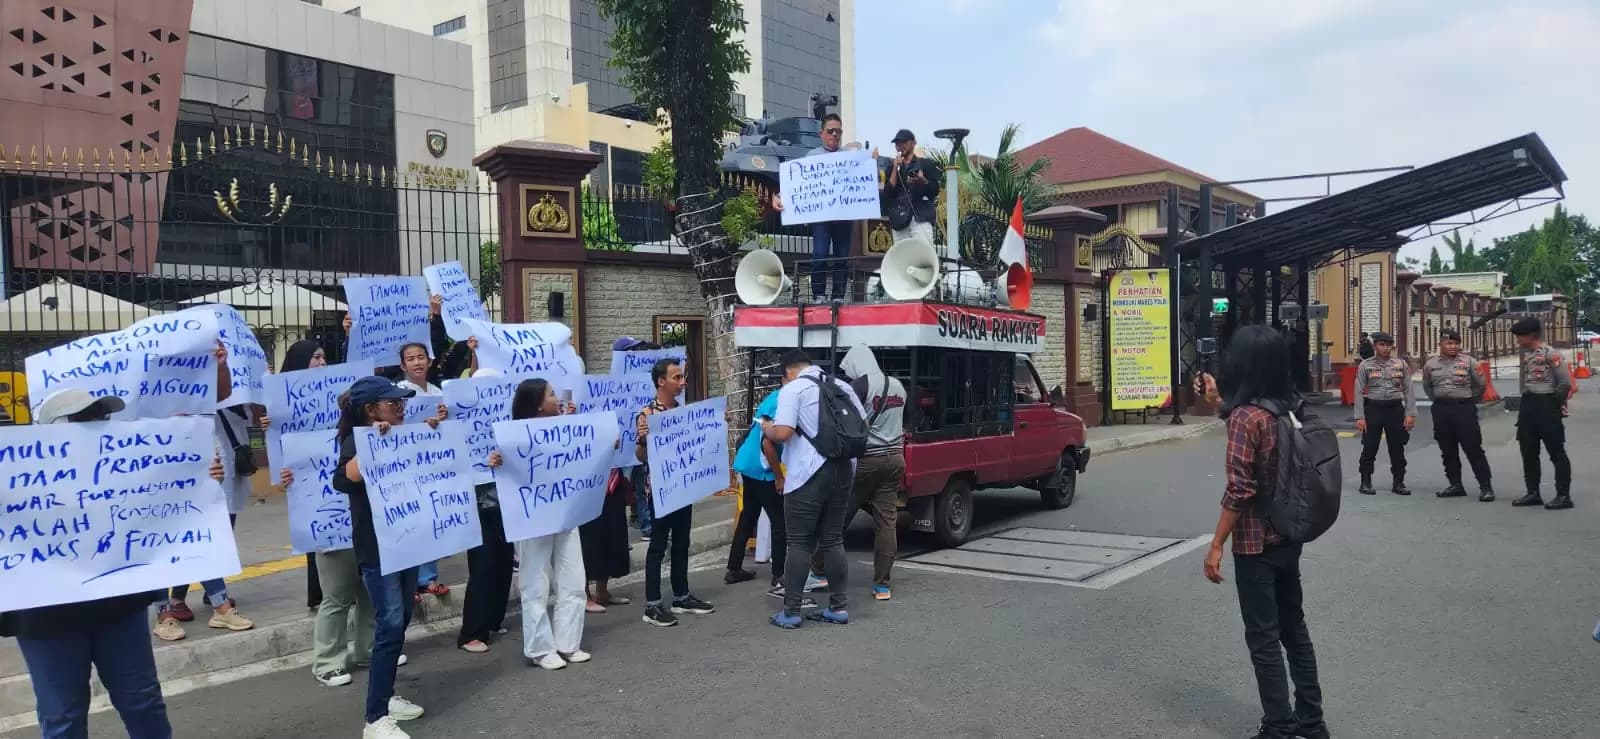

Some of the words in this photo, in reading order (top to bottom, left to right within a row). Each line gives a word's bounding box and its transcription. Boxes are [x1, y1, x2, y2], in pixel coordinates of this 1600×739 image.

[1118, 287, 1162, 296] PERHATIAN
[45, 319, 202, 356] AOWO
[938, 310, 988, 341] SUARA
[991, 317, 1038, 344] RAKYAT
[42, 358, 129, 388] KORBAN
[143, 352, 208, 373] FITNAH
[510, 342, 555, 367] ANTI
[281, 419, 309, 434] DAN
[99, 434, 173, 455] BUKU
[93, 452, 202, 486] PRABOWO
[528, 443, 592, 484] FITNAH
[429, 490, 470, 519] FITNAH
[518, 474, 605, 519] PRABOWO
[432, 511, 469, 540] HOAKS
[125, 528, 212, 561] FITNAH
